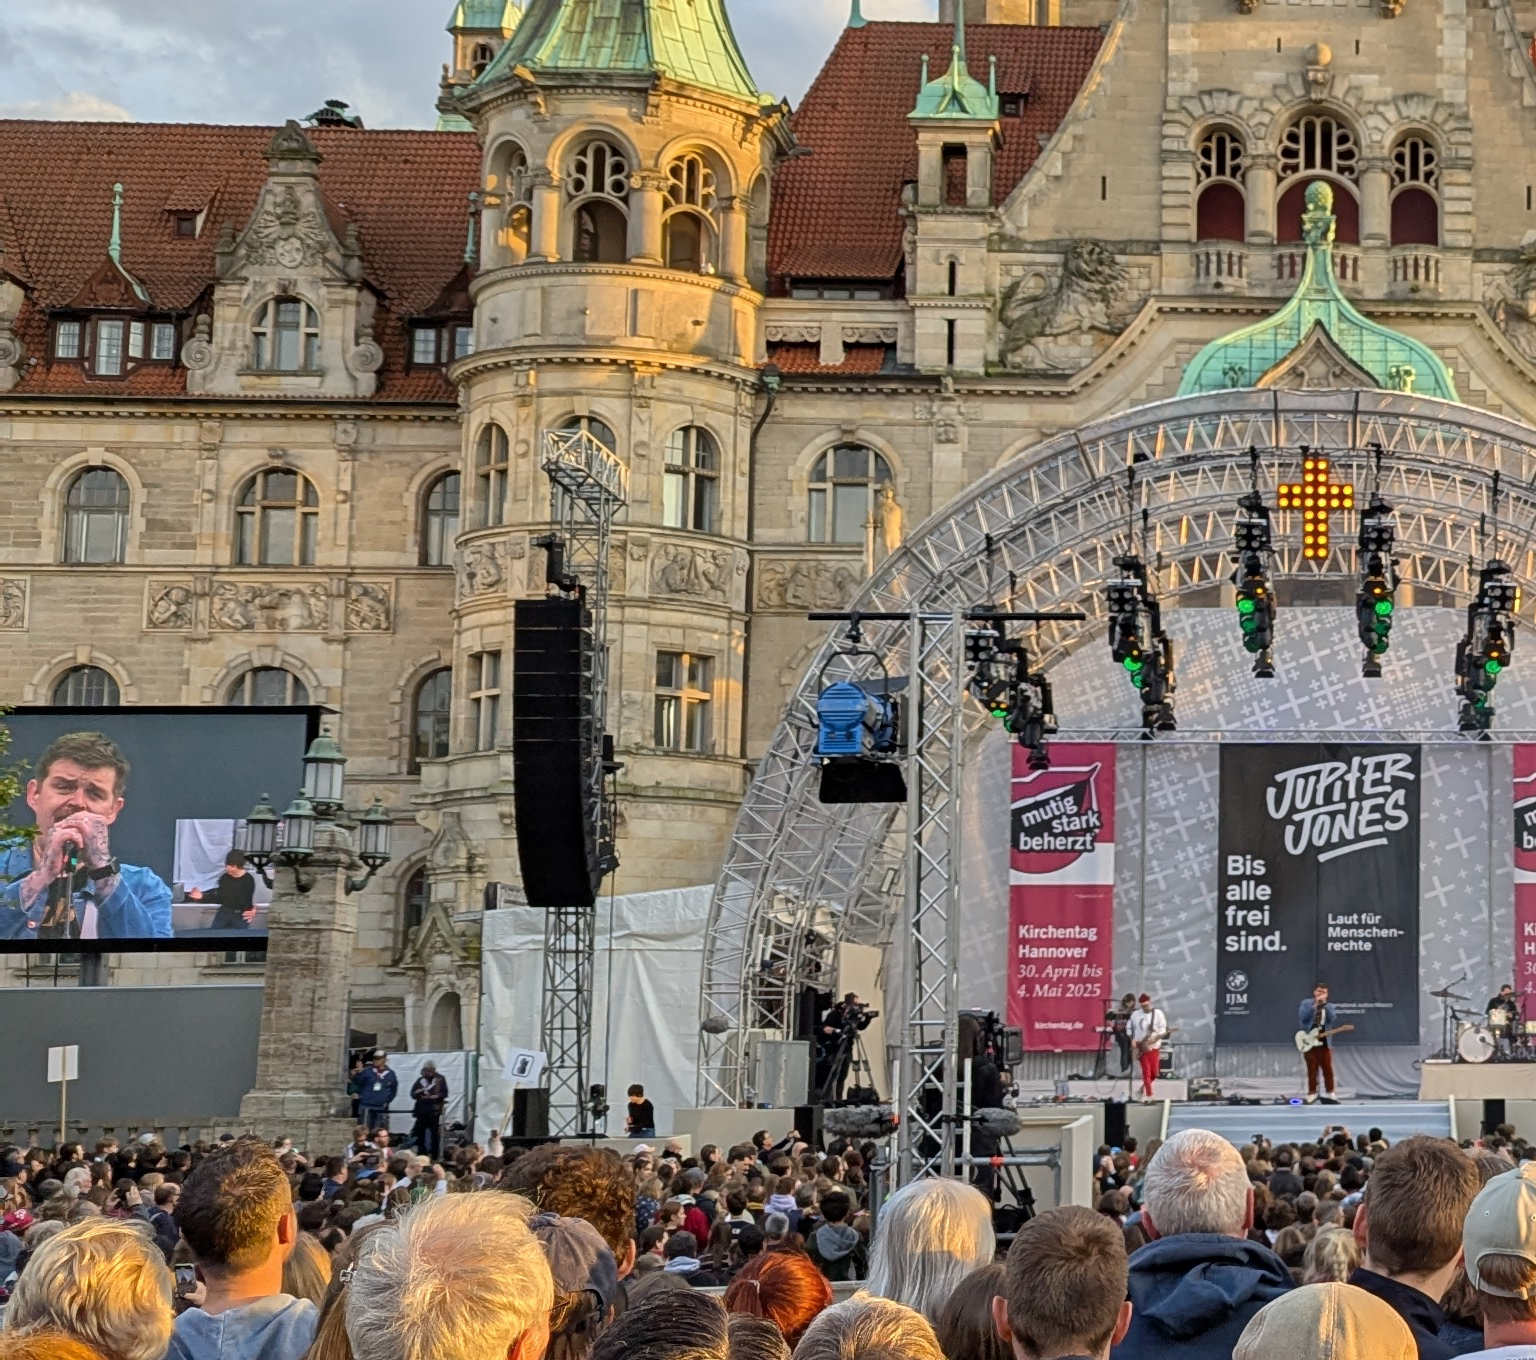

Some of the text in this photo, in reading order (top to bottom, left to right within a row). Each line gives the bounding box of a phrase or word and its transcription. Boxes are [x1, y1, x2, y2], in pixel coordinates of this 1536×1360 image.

[1266, 753, 1416, 820] JUPITER
[1021, 795, 1079, 827] mutig
[1051, 810, 1101, 834] stark
[1284, 789, 1409, 856] JONES
[1227, 855, 1266, 876] Bis
[1226, 880, 1272, 901] alle
[1225, 905, 1270, 926] frei
[1328, 913, 1381, 925] Laut für
[1019, 925, 1097, 941] Kirchentag
[1225, 931, 1287, 952] sind.
[1328, 926, 1405, 938] Menschen-
[1019, 945, 1088, 958] Hannover
[1328, 940, 1372, 951] rechte
[1017, 964, 1103, 981] 30. April bis
[1017, 983, 1101, 997] 4. Mai 2025
[1524, 981, 1536, 994] 4.
